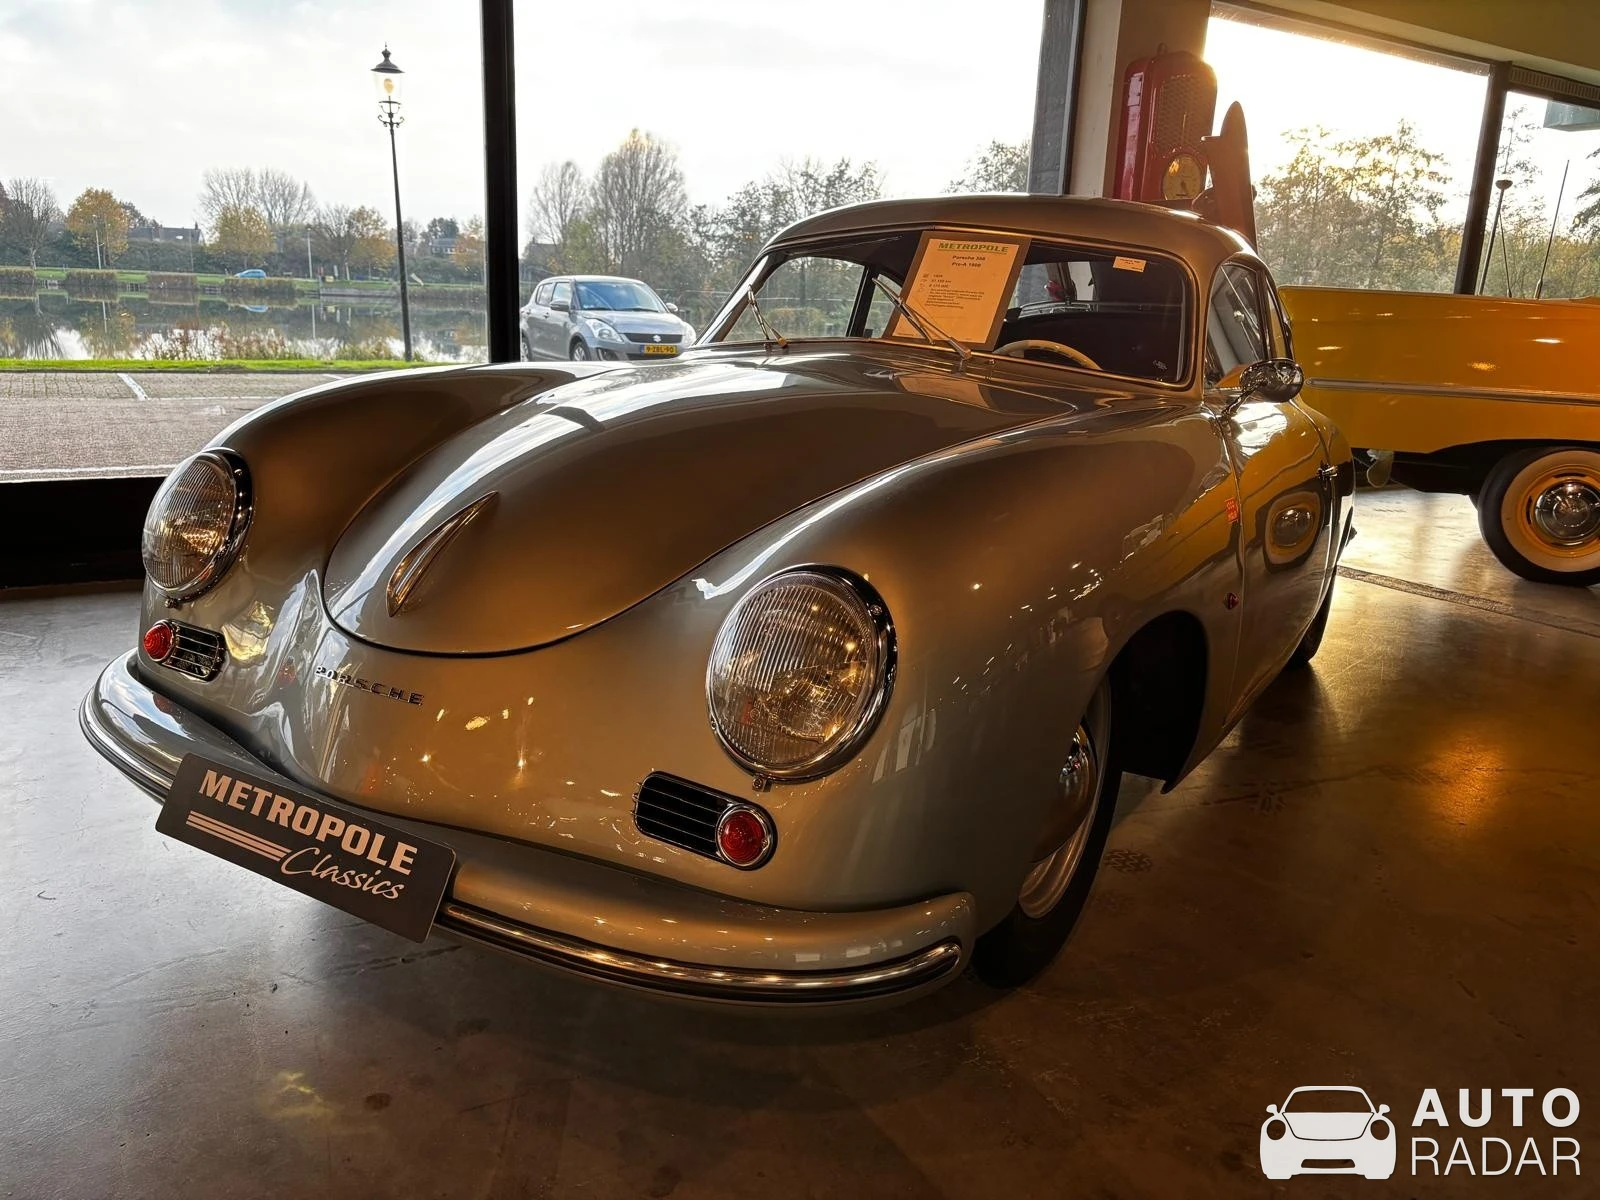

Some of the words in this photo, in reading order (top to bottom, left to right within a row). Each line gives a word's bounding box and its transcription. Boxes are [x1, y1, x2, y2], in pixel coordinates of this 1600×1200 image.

[938, 242, 1009, 253] METROPOLE
[314, 665, 425, 706] PORSCHE
[198, 769, 418, 876] METROPOLE
[280, 847, 405, 900] Classics
